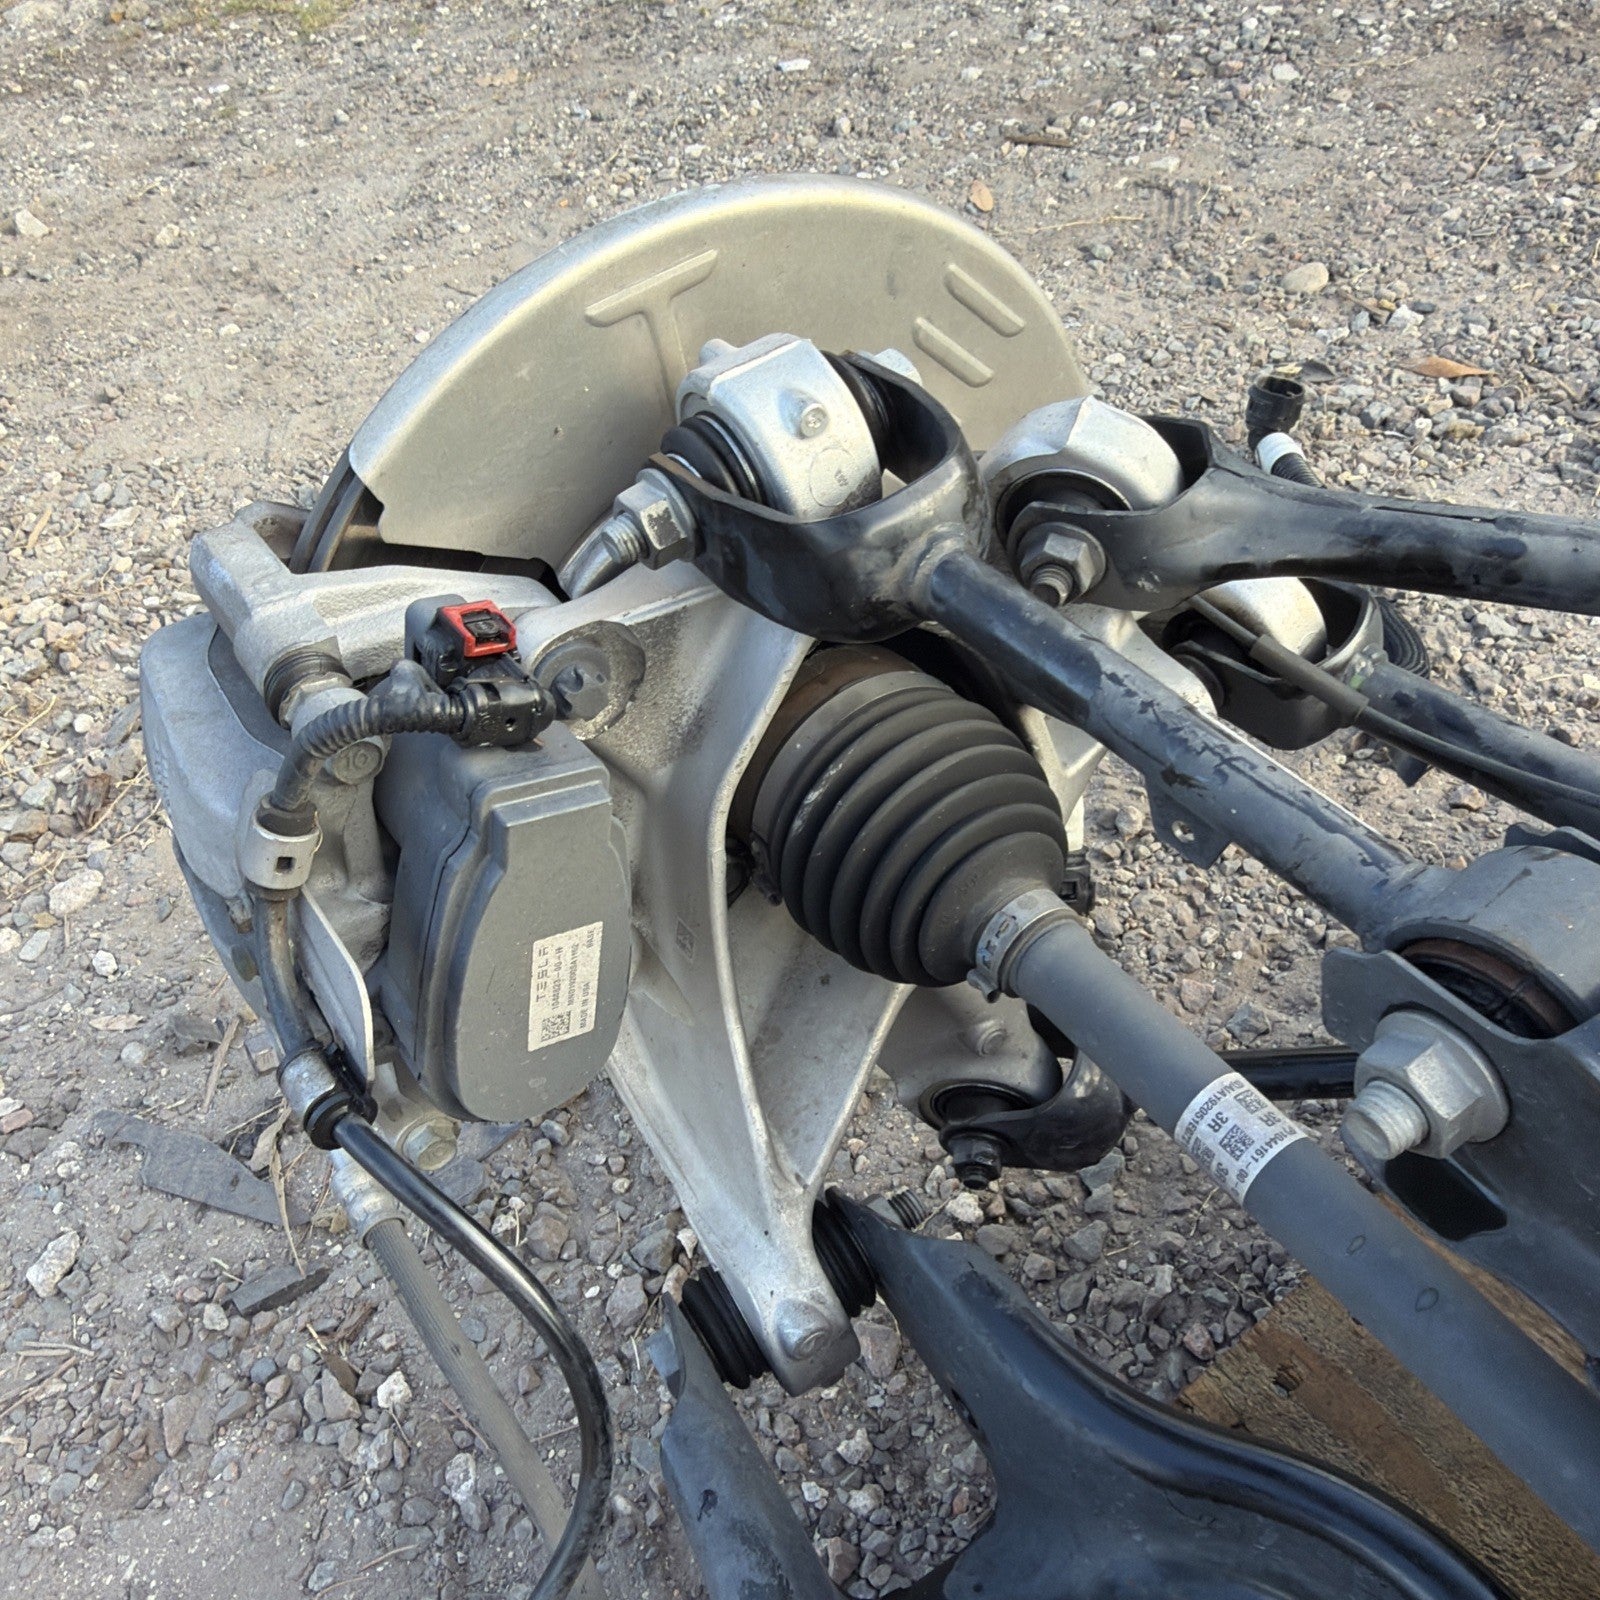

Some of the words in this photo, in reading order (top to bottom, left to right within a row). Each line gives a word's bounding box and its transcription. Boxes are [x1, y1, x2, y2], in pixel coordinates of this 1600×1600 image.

[537, 947, 549, 1003] TESLA
[581, 998, 588, 1008] IN
[580, 1009, 588, 1029] MADE
[1207, 1111, 1229, 1134] 3R
[1259, 1110, 1282, 1128] 3R
